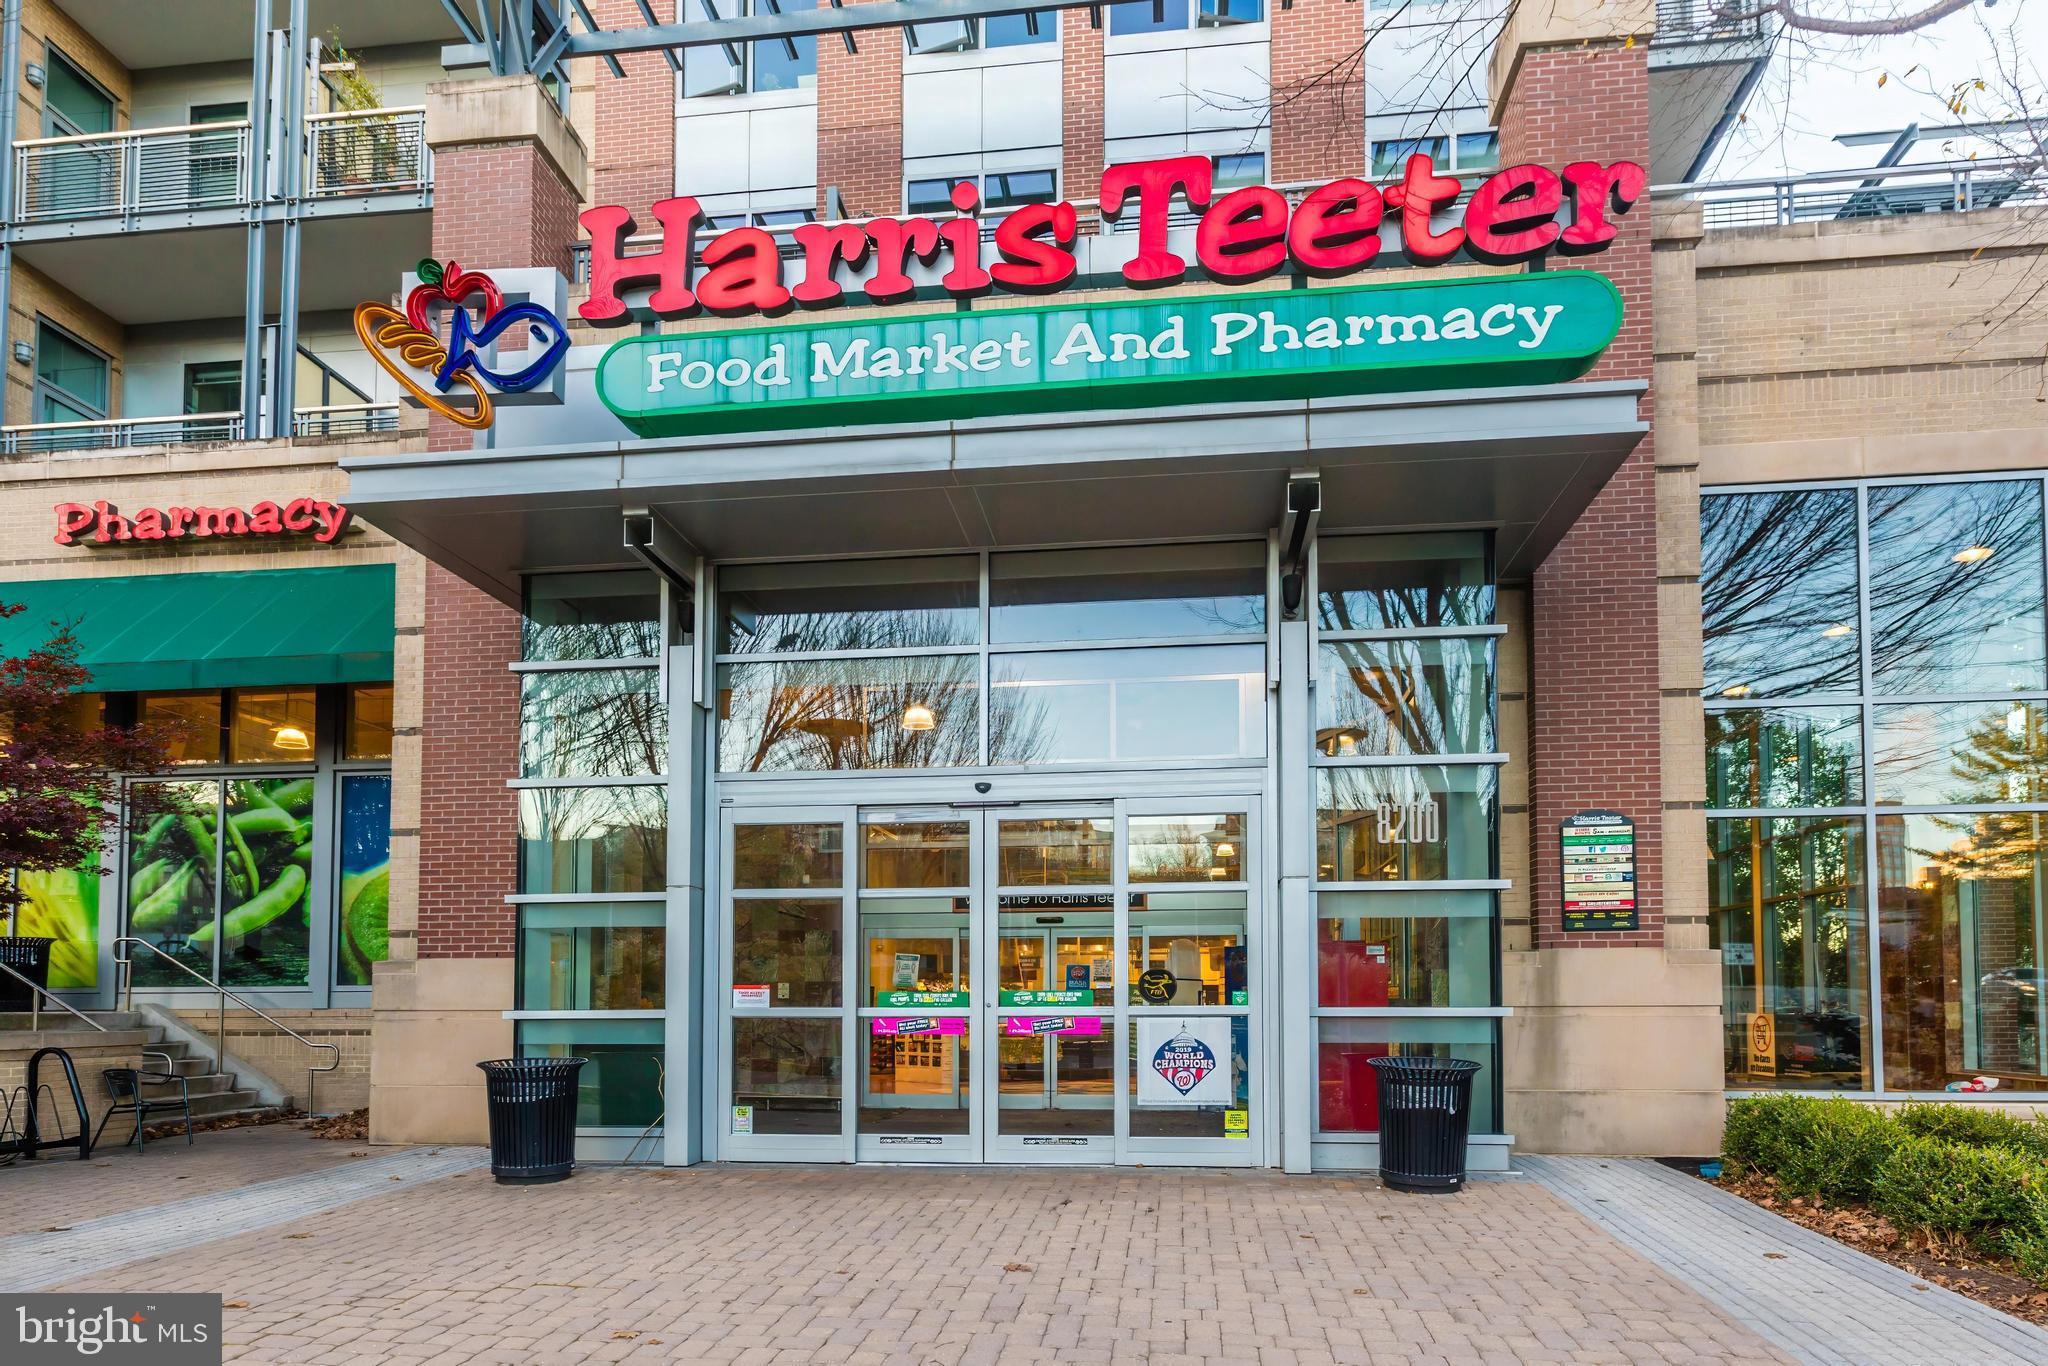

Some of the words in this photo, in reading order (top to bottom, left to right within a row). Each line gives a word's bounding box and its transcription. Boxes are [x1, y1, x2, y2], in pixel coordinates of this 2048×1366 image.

[578, 181, 1079, 326] Harris
[1101, 153, 1646, 288] Teeter
[647, 343, 791, 393] Food
[809, 331, 1032, 383] Market
[1051, 316, 1190, 366] And
[1210, 302, 1564, 358] Pharmacy
[54, 497, 348, 546] Pharmacy
[1377, 801, 1440, 844] 8200
[1154, 1059, 1214, 1070] CHAMPIONS
[1164, 1051, 1205, 1060] WORLD
